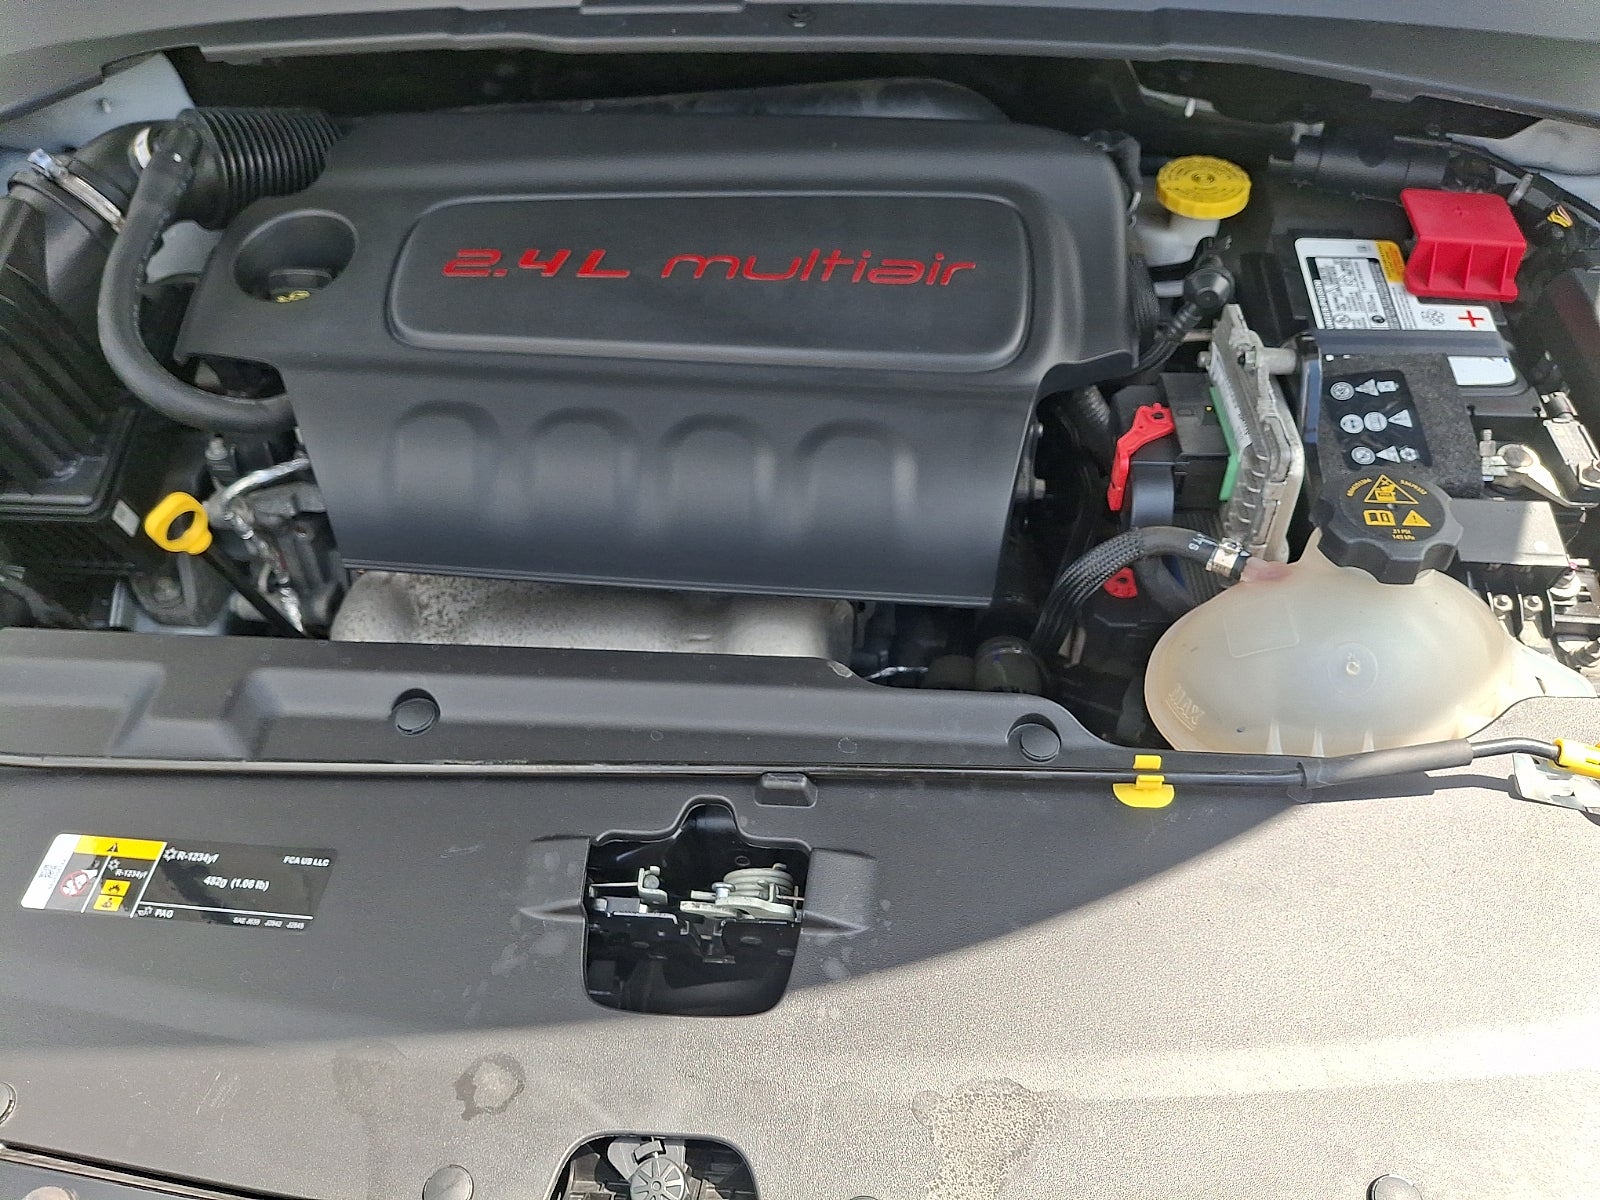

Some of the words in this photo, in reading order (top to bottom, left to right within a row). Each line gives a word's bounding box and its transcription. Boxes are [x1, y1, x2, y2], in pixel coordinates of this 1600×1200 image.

[442, 248, 631, 279] 2.4L
[660, 248, 976, 287] multiair
[312, 858, 330, 867] LLC
